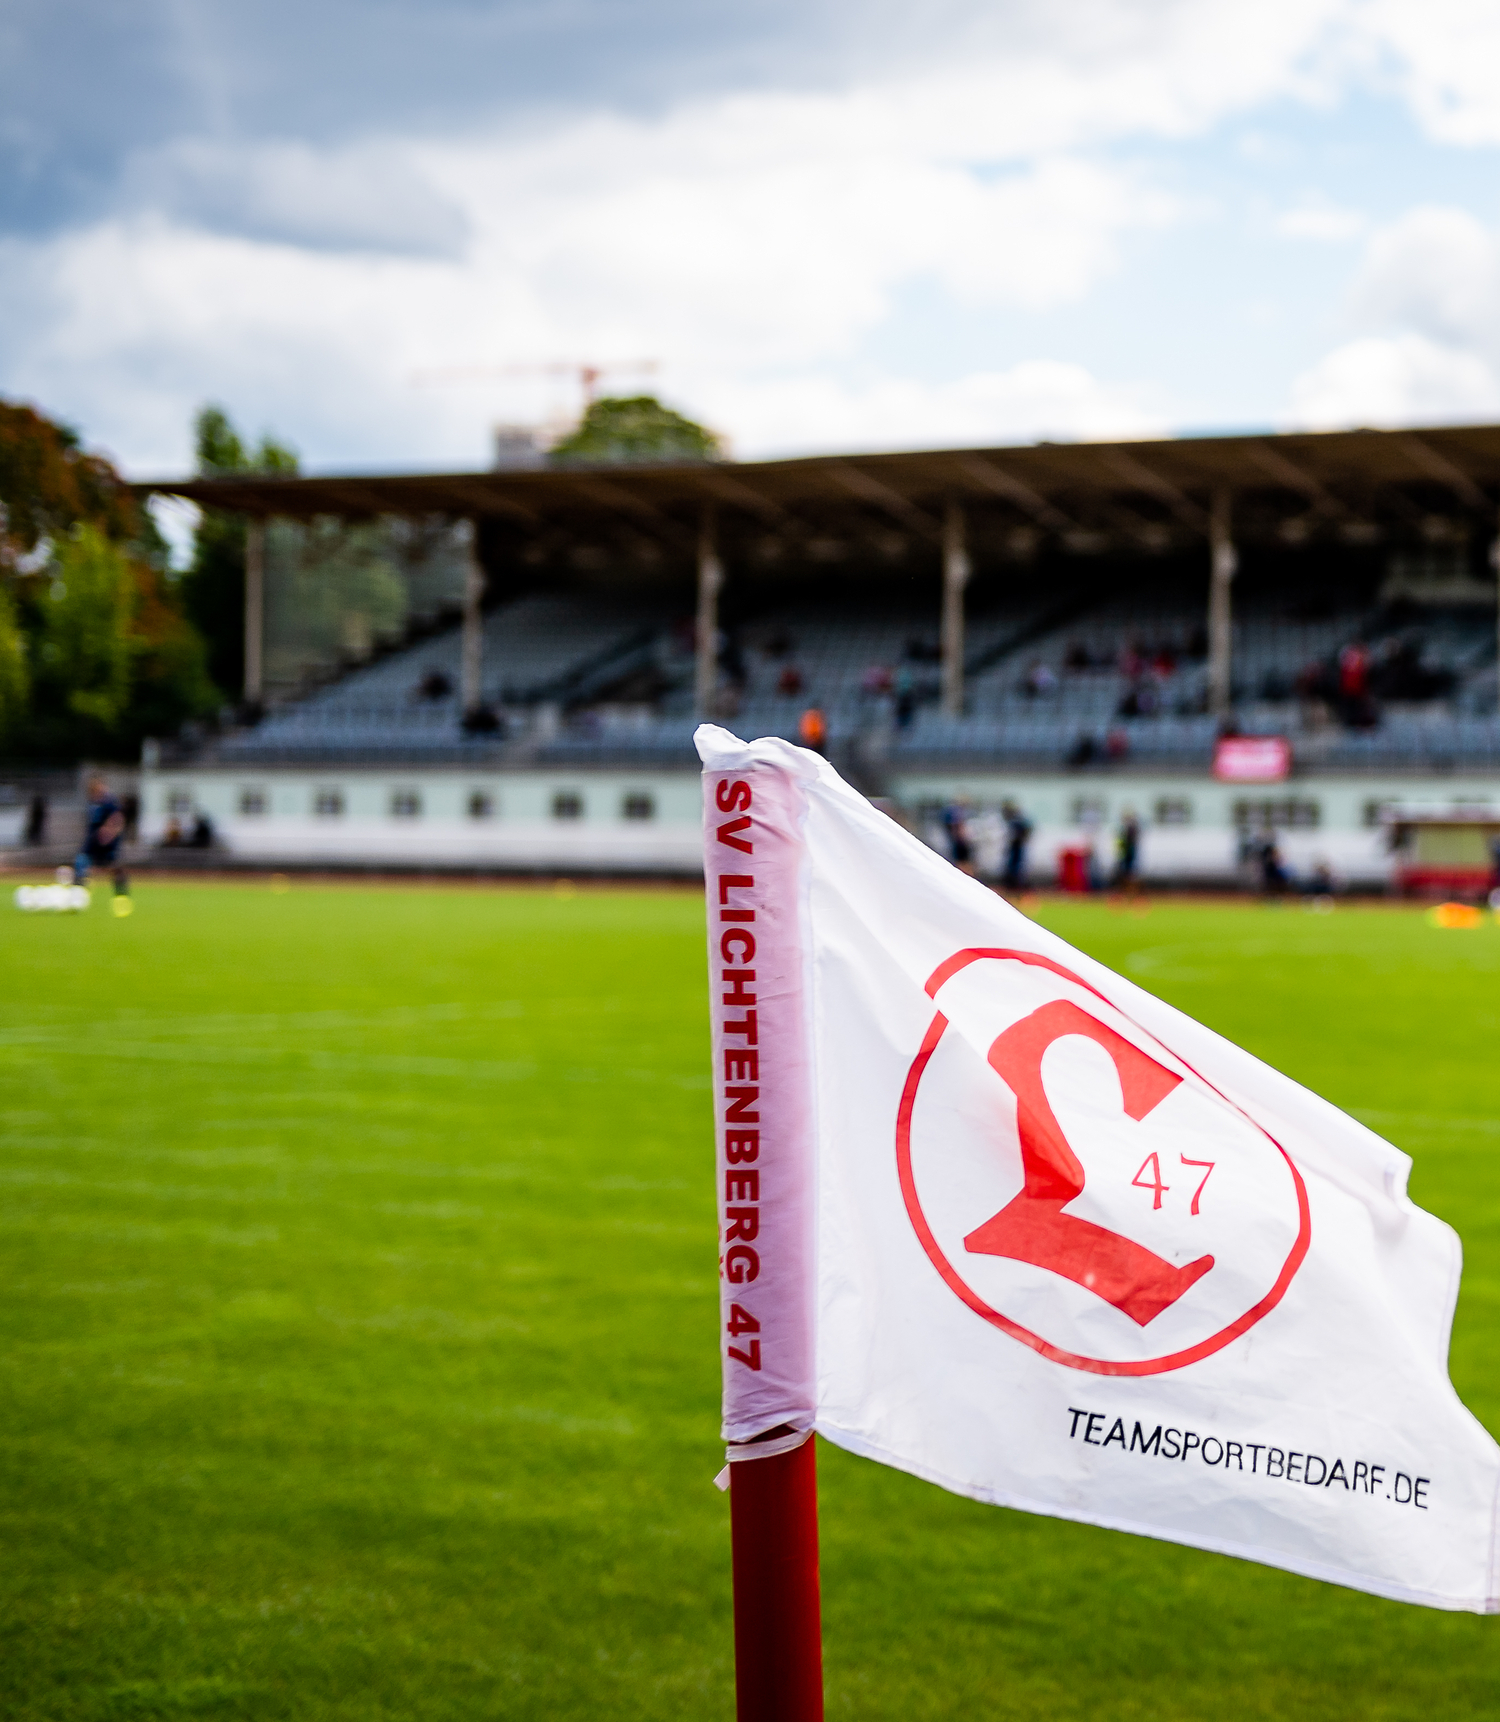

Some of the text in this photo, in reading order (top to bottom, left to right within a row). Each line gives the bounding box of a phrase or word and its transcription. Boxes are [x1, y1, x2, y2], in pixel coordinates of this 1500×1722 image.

[716, 779, 762, 1372] SV LICHTENBERG 47
[1131, 1151, 1215, 1216] 47
[1067, 1407, 1431, 1510] TEAMSPORTBEDARF.DE
